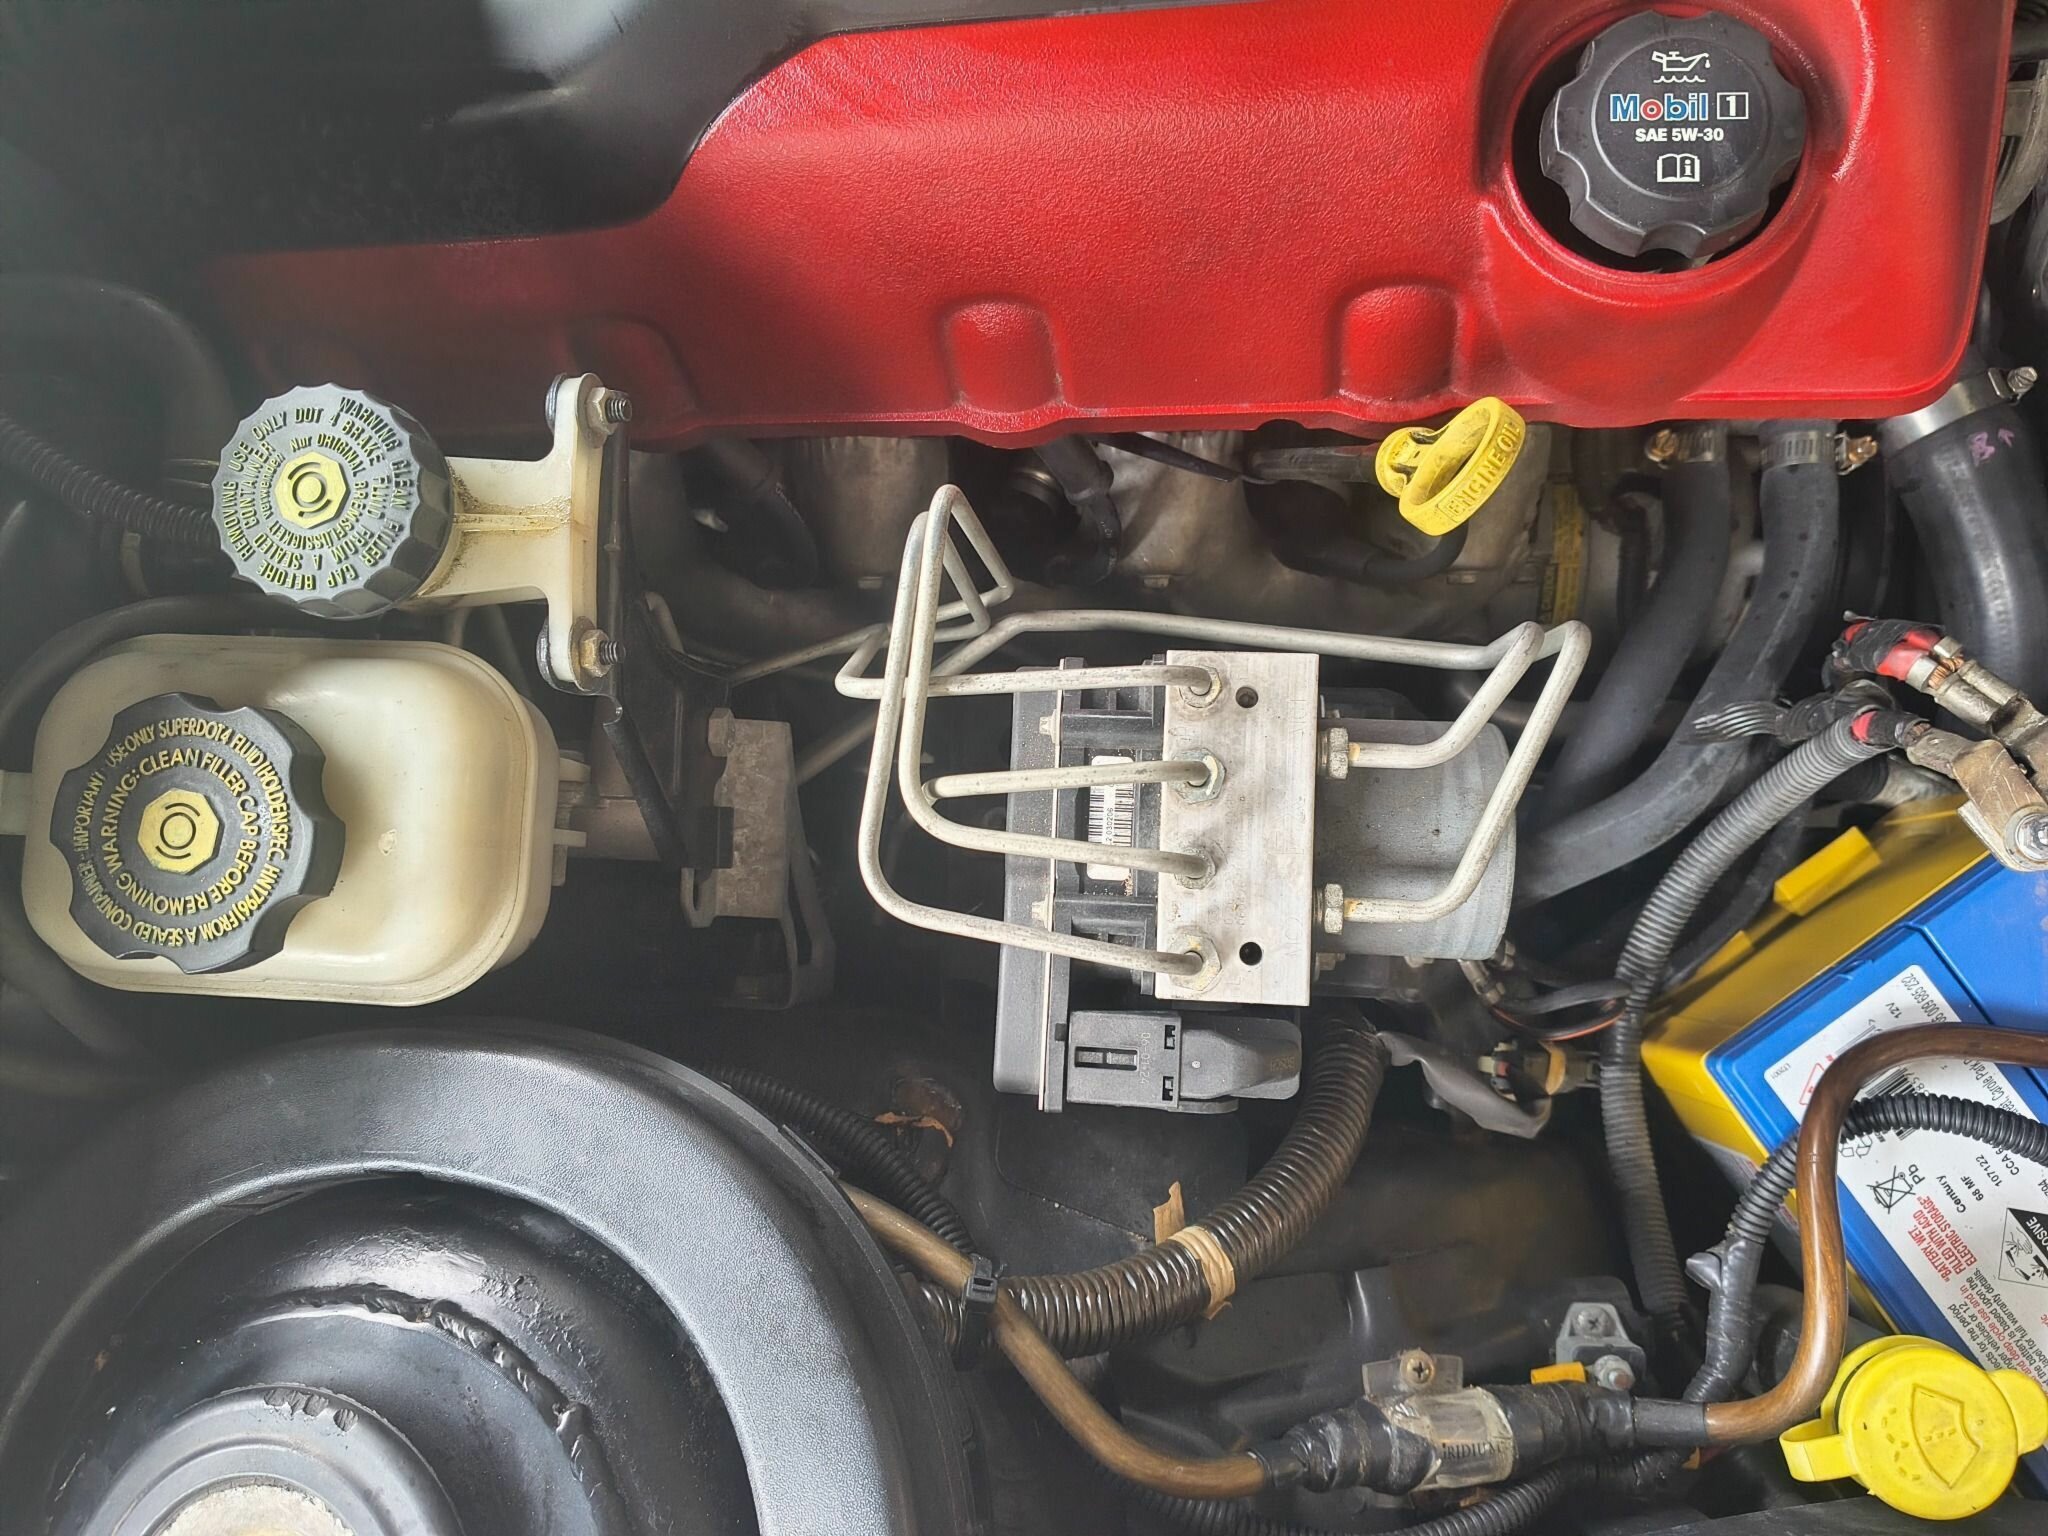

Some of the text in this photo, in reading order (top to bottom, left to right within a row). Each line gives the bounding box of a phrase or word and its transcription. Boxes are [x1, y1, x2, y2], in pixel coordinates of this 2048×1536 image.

[1609, 92, 1709, 122] Mobil
[1634, 127, 1725, 142] SAE 5W-30
[316, 433, 367, 477] ORIGINAL
[1447, 421, 1522, 517] ENGINE OIL
[221, 396, 416, 591] WARNING CLEAN FILLER CAP BEFORE REMOVING
[229, 406, 392, 571] USE ONLY DOT 4 BRAKE FLUID FROM A SEALED CONTAINER
[259, 454, 286, 520] verwenden
[71, 770, 108, 853] IMPORTANT
[99, 747, 260, 917] WARNING: CLEAN FILLER CAP BEFORE REMOVING
[76, 859, 134, 931] CONTAINER
[132, 919, 186, 949] SEALED
[186, 925, 198, 945] A
[201, 911, 243, 942] FROM
[1899, 971, 1920, 992] 232
[1909, 984, 1930, 1005] 685
[1884, 999, 1904, 1020] 12V
[1920, 997, 1940, 1018] 009
[1966, 1058, 1989, 1081] Park
[1978, 1072, 2007, 1102] Carole
[1903, 1161, 1926, 1186] Pb
[1974, 1153, 2004, 1188] 107122
[1999, 1152, 2021, 1177] CCA
[1933, 1172, 1969, 1215] Century
[1959, 1172, 1985, 1202] 68 MF
[1905, 1223, 1927, 1247] WET.
[1911, 1207, 1967, 1276] FILLED WITH ACID
[1944, 1227, 1978, 1268] ELECTRIC
[1957, 1283, 1970, 1295] in
[1964, 1275, 1979, 1291] the
[1969, 1266, 1995, 1296] details.
[1957, 1299, 1971, 1314] 12
[1963, 1291, 1981, 1310] and
[1974, 1286, 1995, 1310] upon
[1989, 1291, 2020, 1327] warranty
[1946, 1301, 1972, 1330] period
[1967, 1310, 1979, 1323] or
[1977, 1307, 1992, 1323] use
[1988, 1307, 2010, 1333] based
[1964, 1325, 1980, 1342] the
[1972, 1319, 2001, 1354] vehicles
[1985, 1319, 2008, 1344] cycle
[2005, 1328, 2017, 1340] is
[2013, 1323, 2029, 1340] full
[2023, 1335, 2037, 1350] for
[1974, 1339, 1989, 1354] for
[2000, 1338, 2022, 1363] deep
[2011, 1335, 2038, 1366] battery
[2031, 1363, 2047, 1379] the
